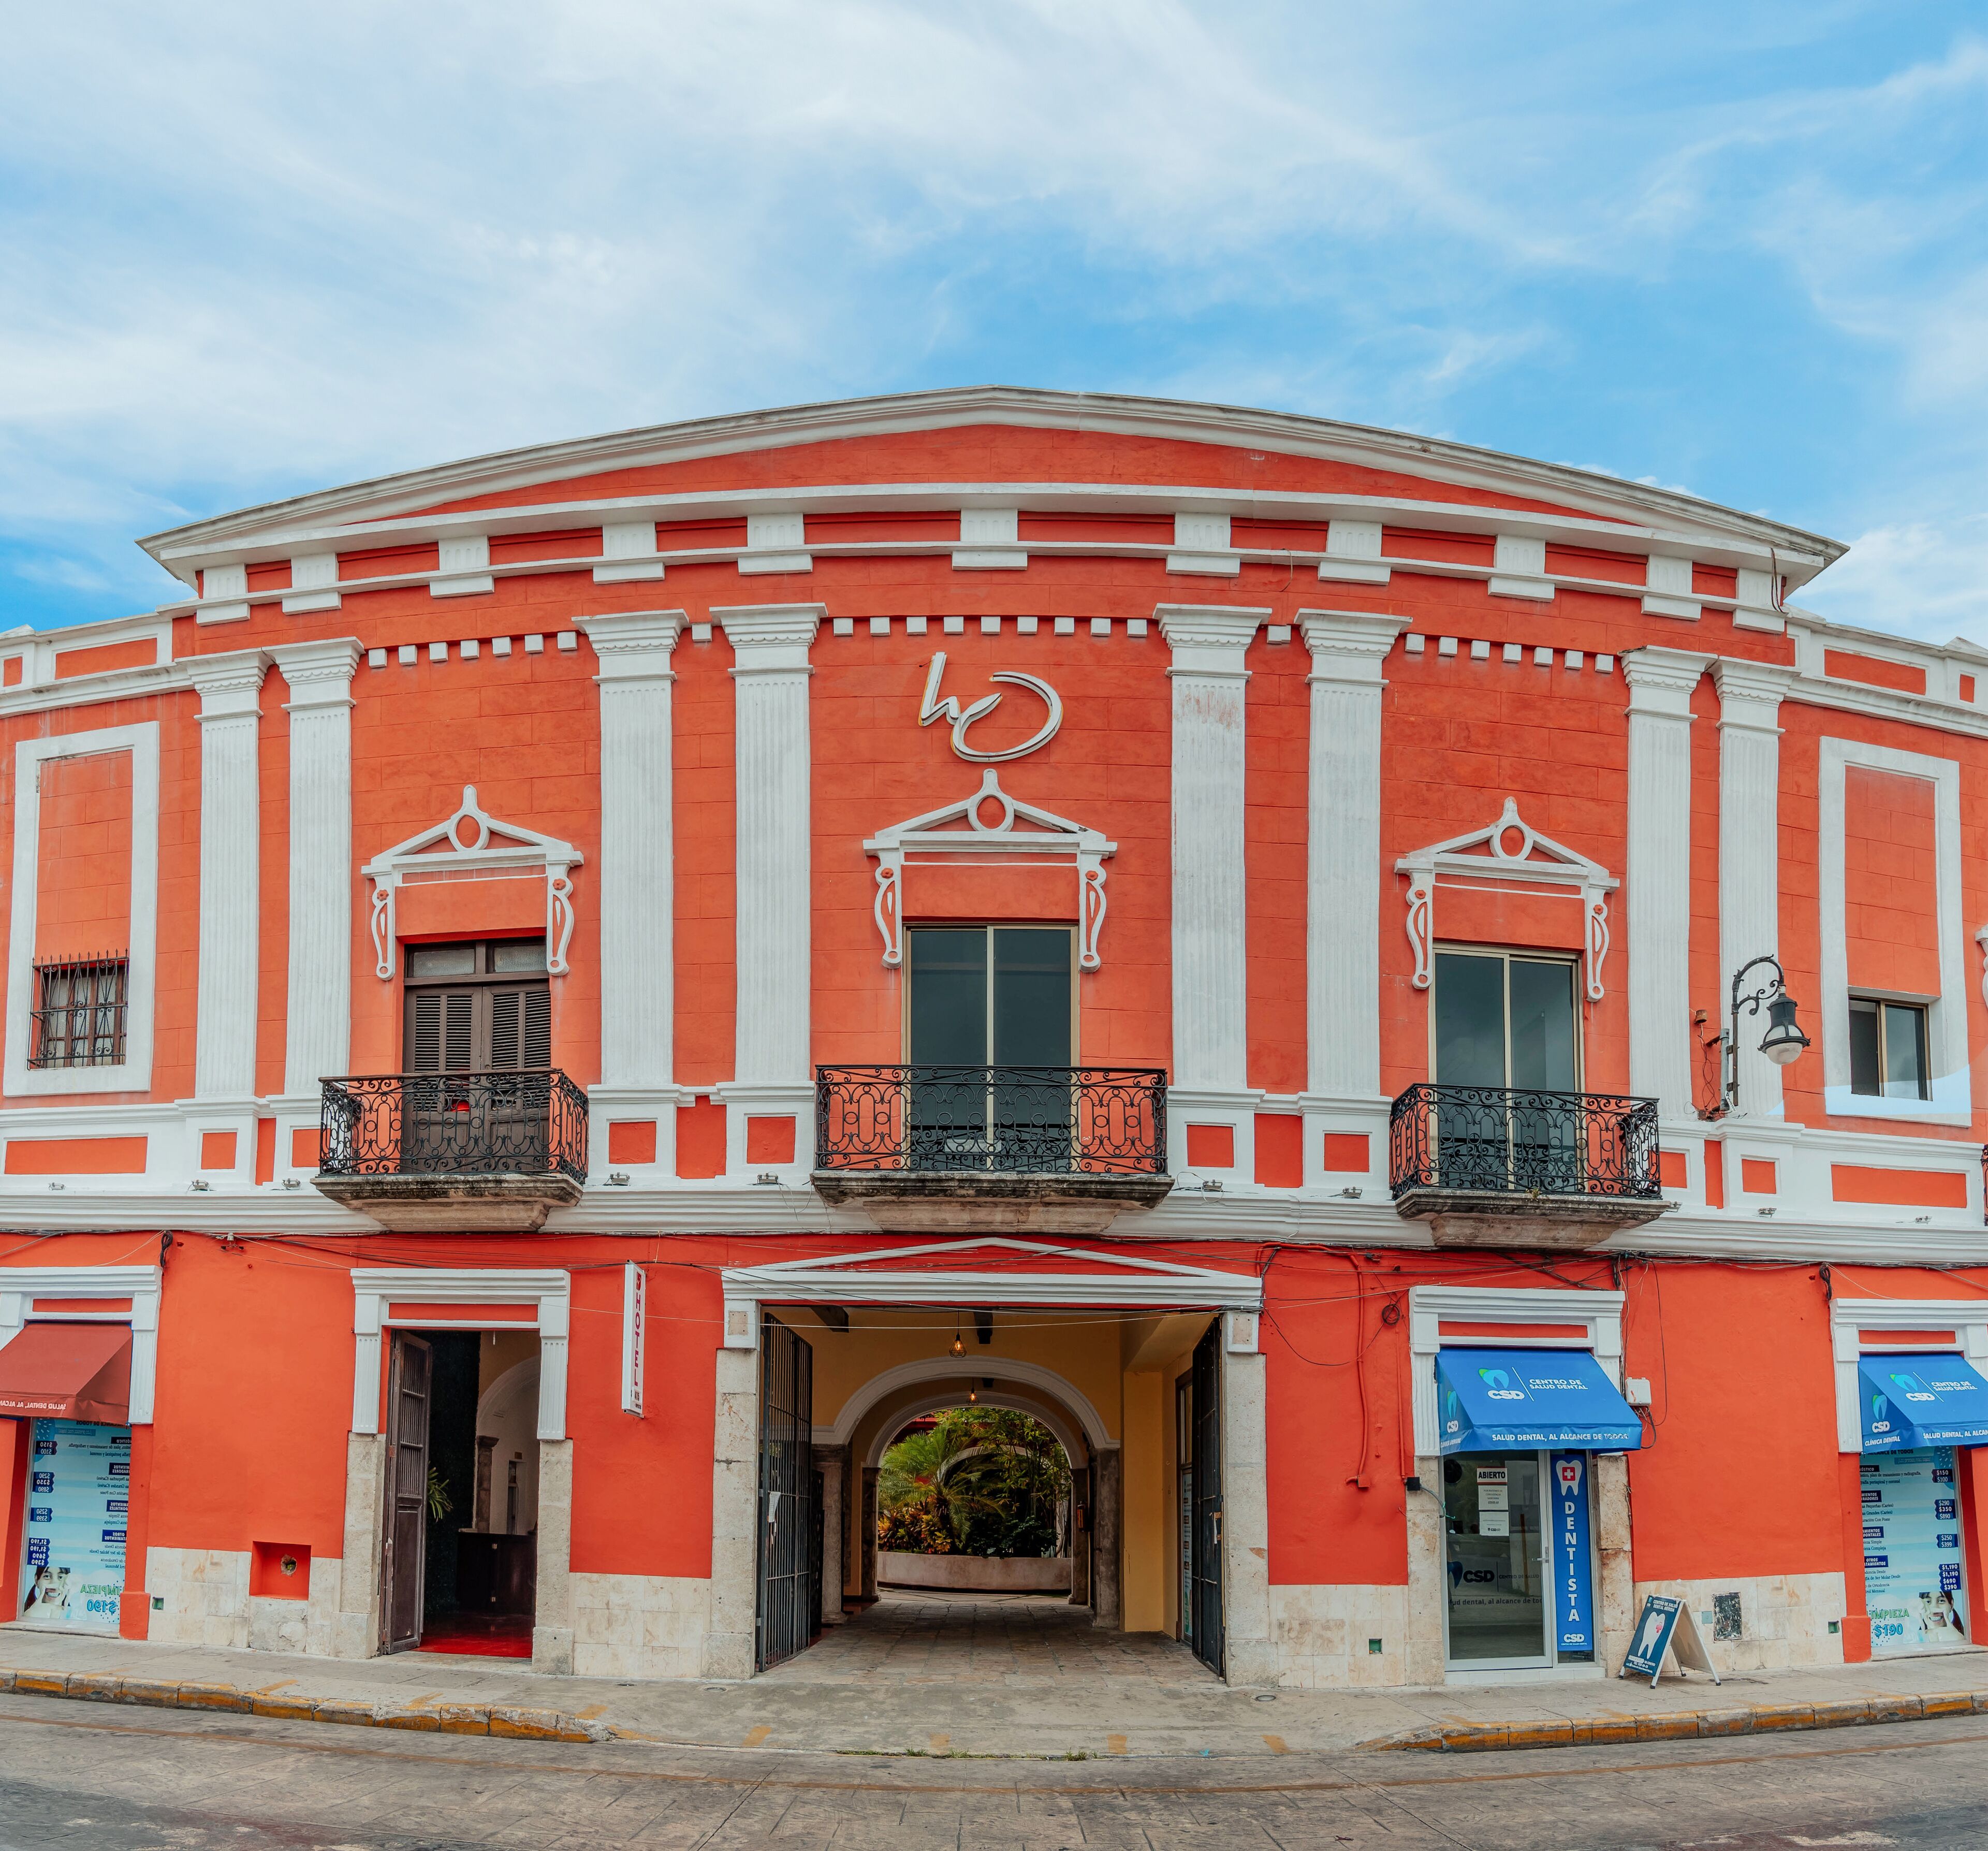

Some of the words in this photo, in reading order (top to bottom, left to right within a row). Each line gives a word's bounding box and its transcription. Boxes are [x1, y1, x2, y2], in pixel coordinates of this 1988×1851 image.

[1487, 1390, 1525, 1400] CSD
[1906, 1392, 1935, 1401] CSD
[1447, 1421, 1459, 1433] CSD
[1872, 1421, 1890, 1433] CSD
[1517, 1434, 1547, 1442] DENTAL,
[1865, 1437, 1883, 1446] CLÍNICA
[1565, 1502, 1580, 1622] DENTISTA
[1463, 1570, 1495, 1583] CSD
[1874, 1623, 1903, 1639] $190
[1564, 1634, 1584, 1642] CSD
